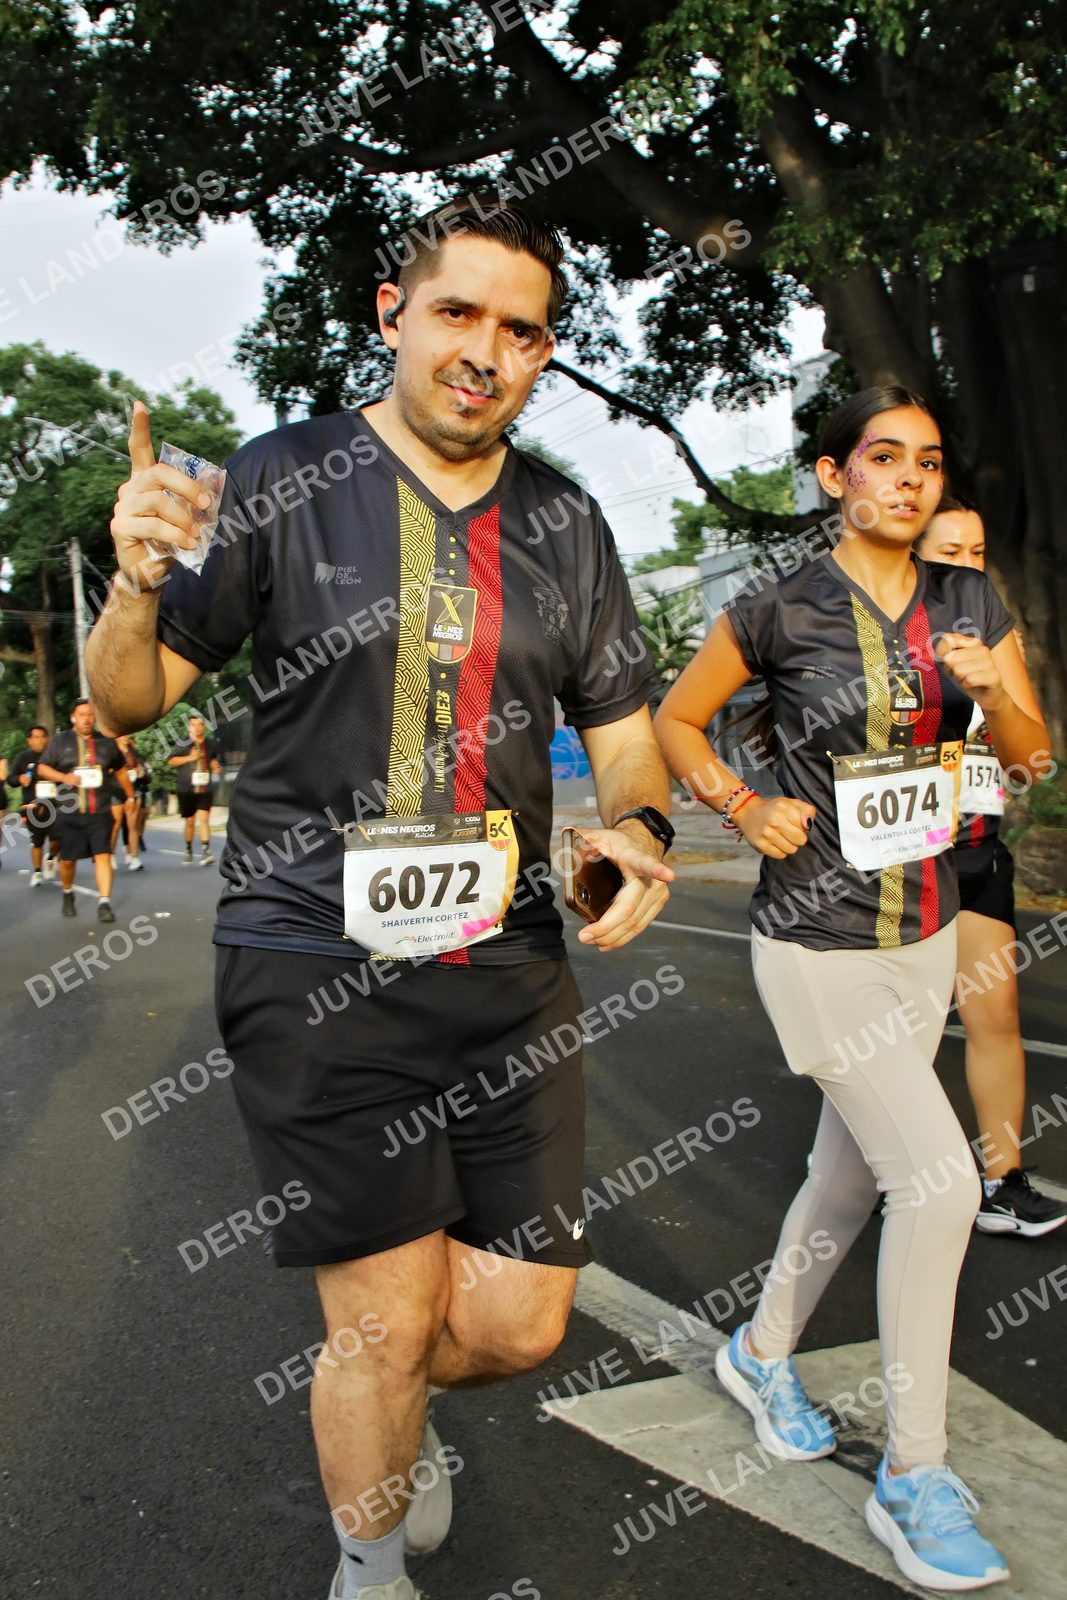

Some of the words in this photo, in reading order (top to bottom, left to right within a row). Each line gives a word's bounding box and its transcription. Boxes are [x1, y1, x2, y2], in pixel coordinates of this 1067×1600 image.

[943, 750, 958, 762] 5K
[966, 764, 1000, 788] 1574
[857, 781, 940, 829] 6074
[399, 824, 436, 834] NEGROS
[489, 822, 509, 838] 5K
[368, 860, 481, 913] 6072
[381, 916, 433, 928] SHAIVERTH
[435, 912, 469, 923] CORTEZ
